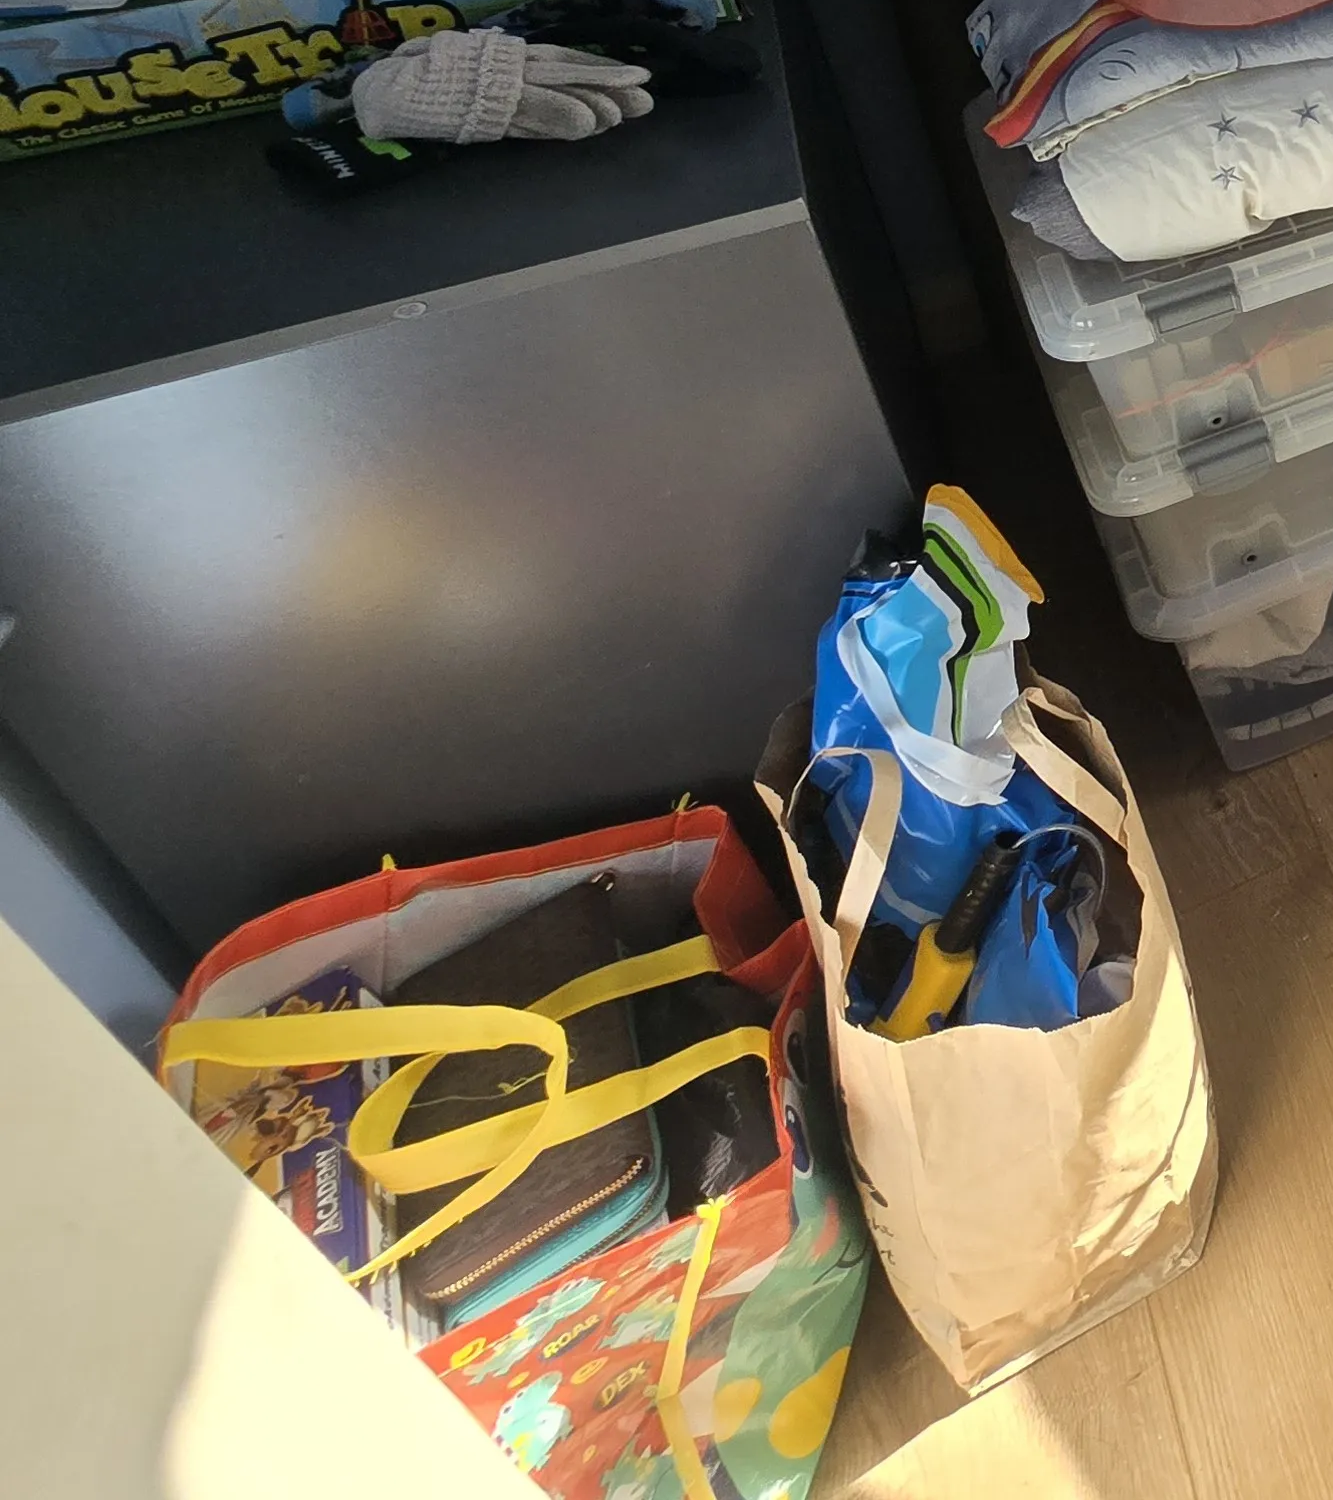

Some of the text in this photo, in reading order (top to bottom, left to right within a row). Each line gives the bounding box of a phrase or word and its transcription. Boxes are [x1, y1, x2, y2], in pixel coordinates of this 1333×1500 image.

[16, 101, 213, 148] The Classic Game Of
[541, 1314, 601, 1359] ROAR
[601, 1360, 648, 1406] DEX
